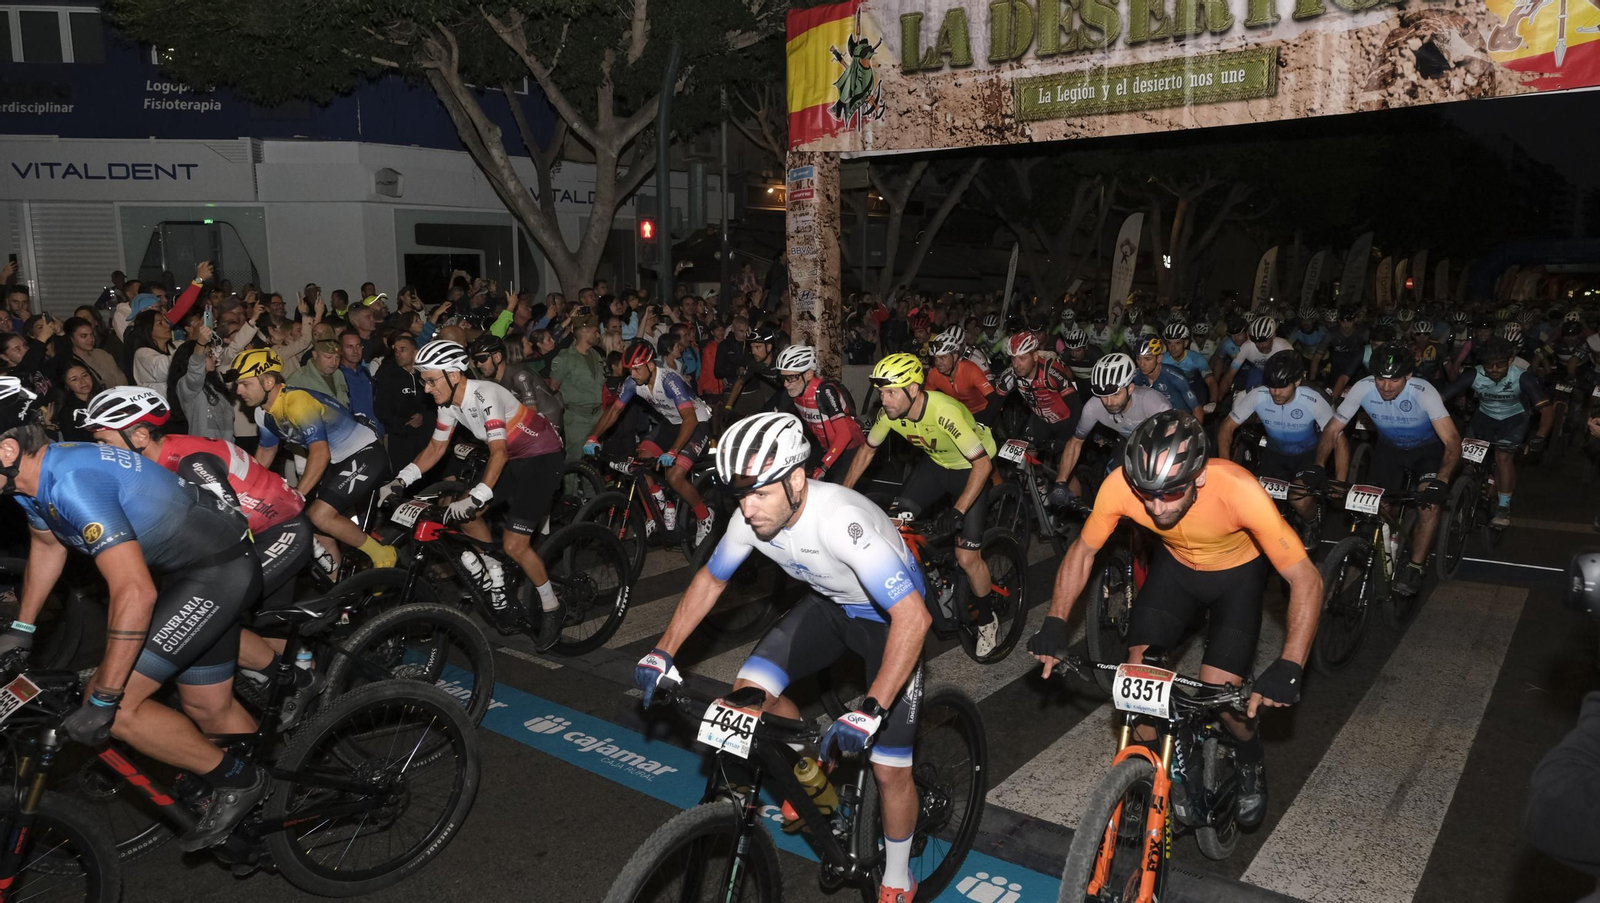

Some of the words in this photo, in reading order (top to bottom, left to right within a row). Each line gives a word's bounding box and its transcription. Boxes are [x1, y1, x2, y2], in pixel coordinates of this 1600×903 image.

[900, 6, 975, 73] LA
[146, 79, 216, 95] Logop
[1038, 87, 1051, 104] La
[1056, 83, 1096, 103] Legión
[1102, 83, 1110, 100] y
[1116, 79, 1128, 96] el
[1132, 73, 1183, 94] desierto
[1190, 71, 1213, 88] nos
[1220, 67, 1246, 84] une
[143, 98, 222, 114] Fisioterapia
[11, 162, 199, 181] VITALDENT
[528, 187, 638, 208] VTALDT
[790, 245, 812, 255] BBVA
[129, 391, 154, 403] KASK
[1463, 443, 1485, 457] 6375
[1262, 480, 1286, 493] 7333
[1352, 491, 1380, 506] 7777
[399, 503, 419, 519] 9116
[152, 595, 205, 645] FUNERARIA
[162, 599, 214, 653] GUILLERMO
[1120, 677, 1165, 703] 8351
[711, 705, 754, 741] 7645
[847, 714, 867, 726] Giro
[562, 729, 679, 777] cajamar
[600, 756, 624, 771] CAJA
[625, 765, 653, 782] RURAL
[127, 836, 158, 855] GROUND
[1146, 838, 1161, 872] FOX
